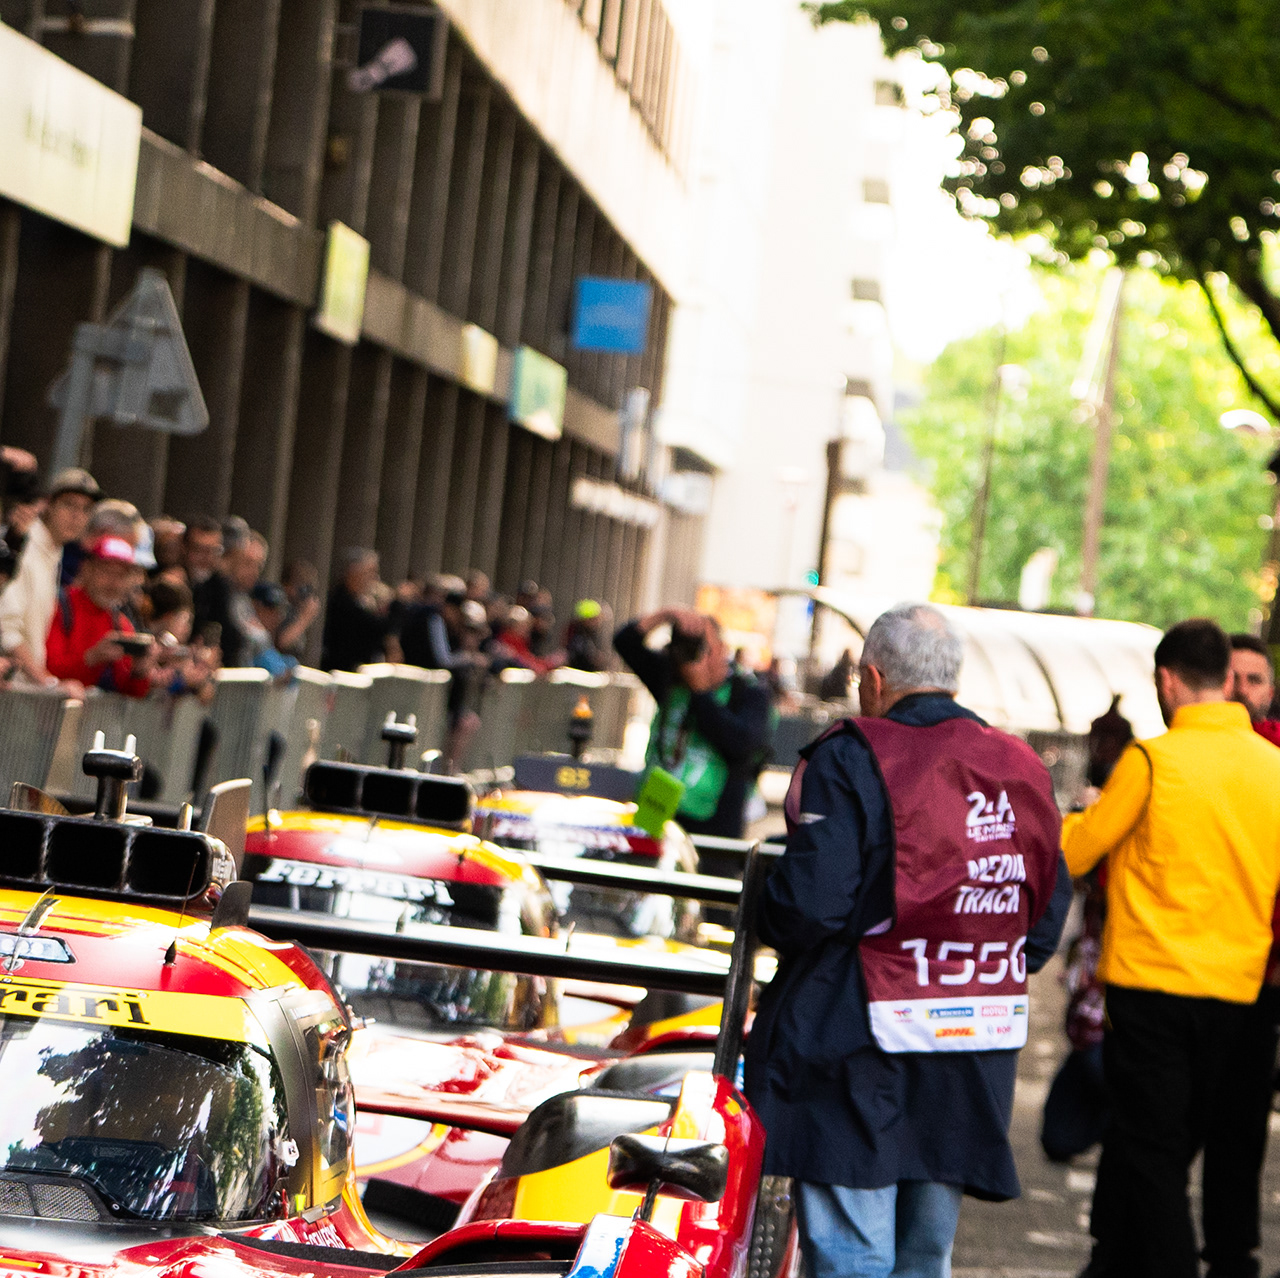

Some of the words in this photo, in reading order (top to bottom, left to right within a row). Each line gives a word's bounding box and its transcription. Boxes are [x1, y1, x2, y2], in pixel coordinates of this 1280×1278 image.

[966, 826, 982, 839] LE
[257, 857, 456, 907] Ferrari
[966, 853, 1027, 883] MEDIA
[954, 884, 1021, 914] TRACK
